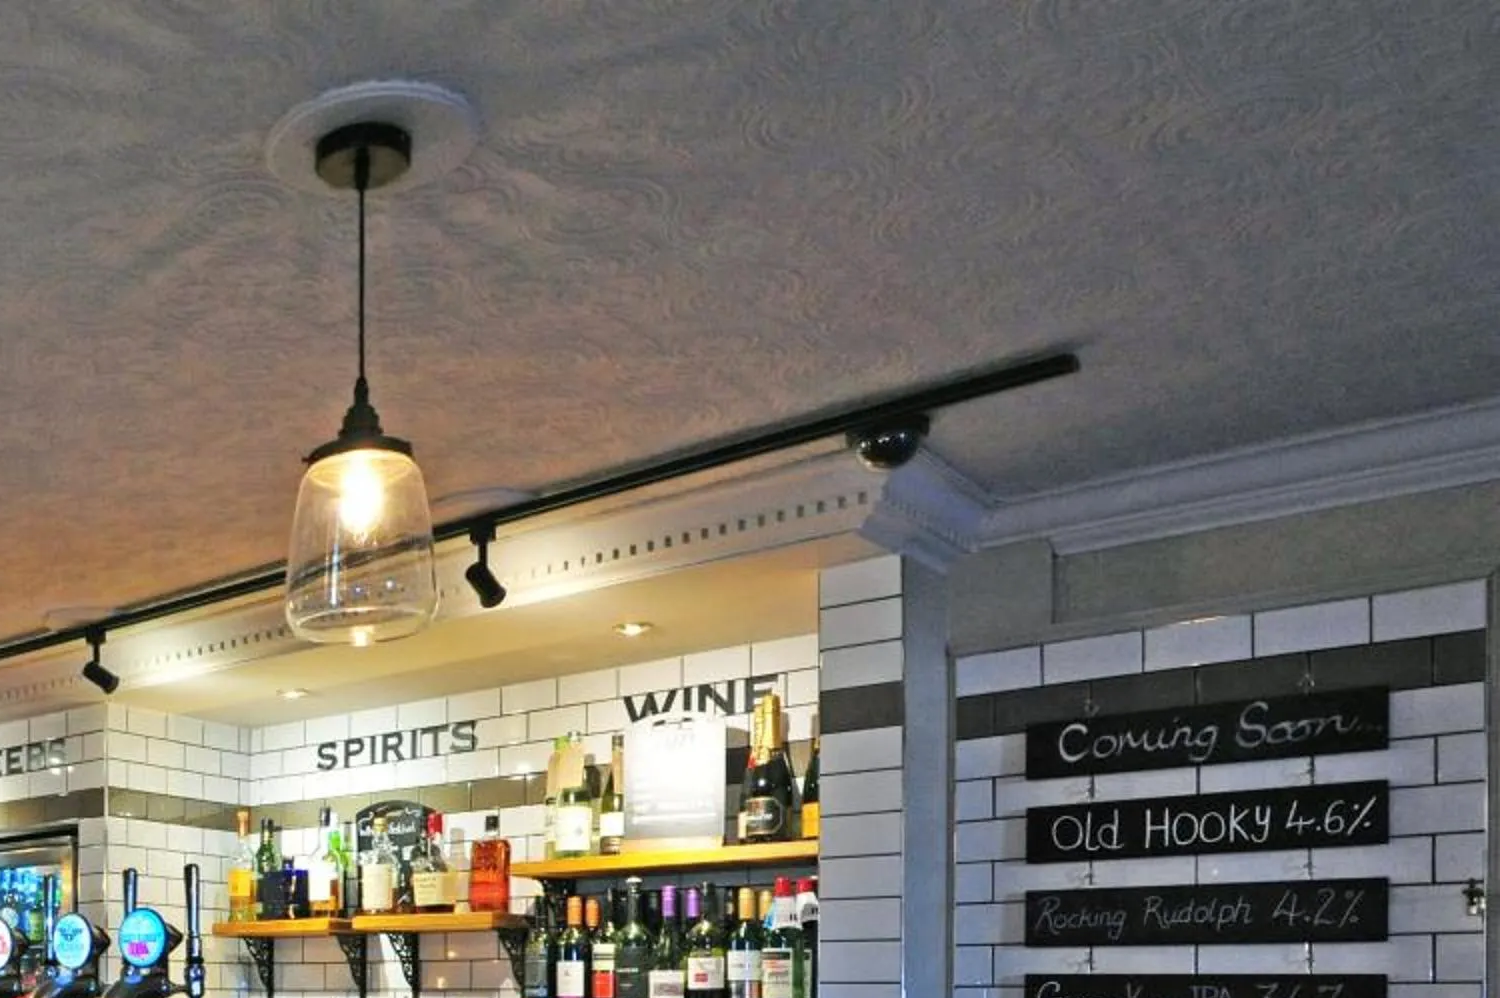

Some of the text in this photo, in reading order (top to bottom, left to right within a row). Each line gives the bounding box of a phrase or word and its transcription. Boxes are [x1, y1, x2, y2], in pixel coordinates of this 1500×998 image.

[623, 674, 779, 722] WINE
[317, 720, 478, 770] SPIRITS
[1058, 716, 1219, 763] Coming
[1052, 808, 1124, 850] Old
[1285, 796, 1377, 835] 4.6%
[1034, 888, 1365, 940] Rocking Rudolph 4.2%
